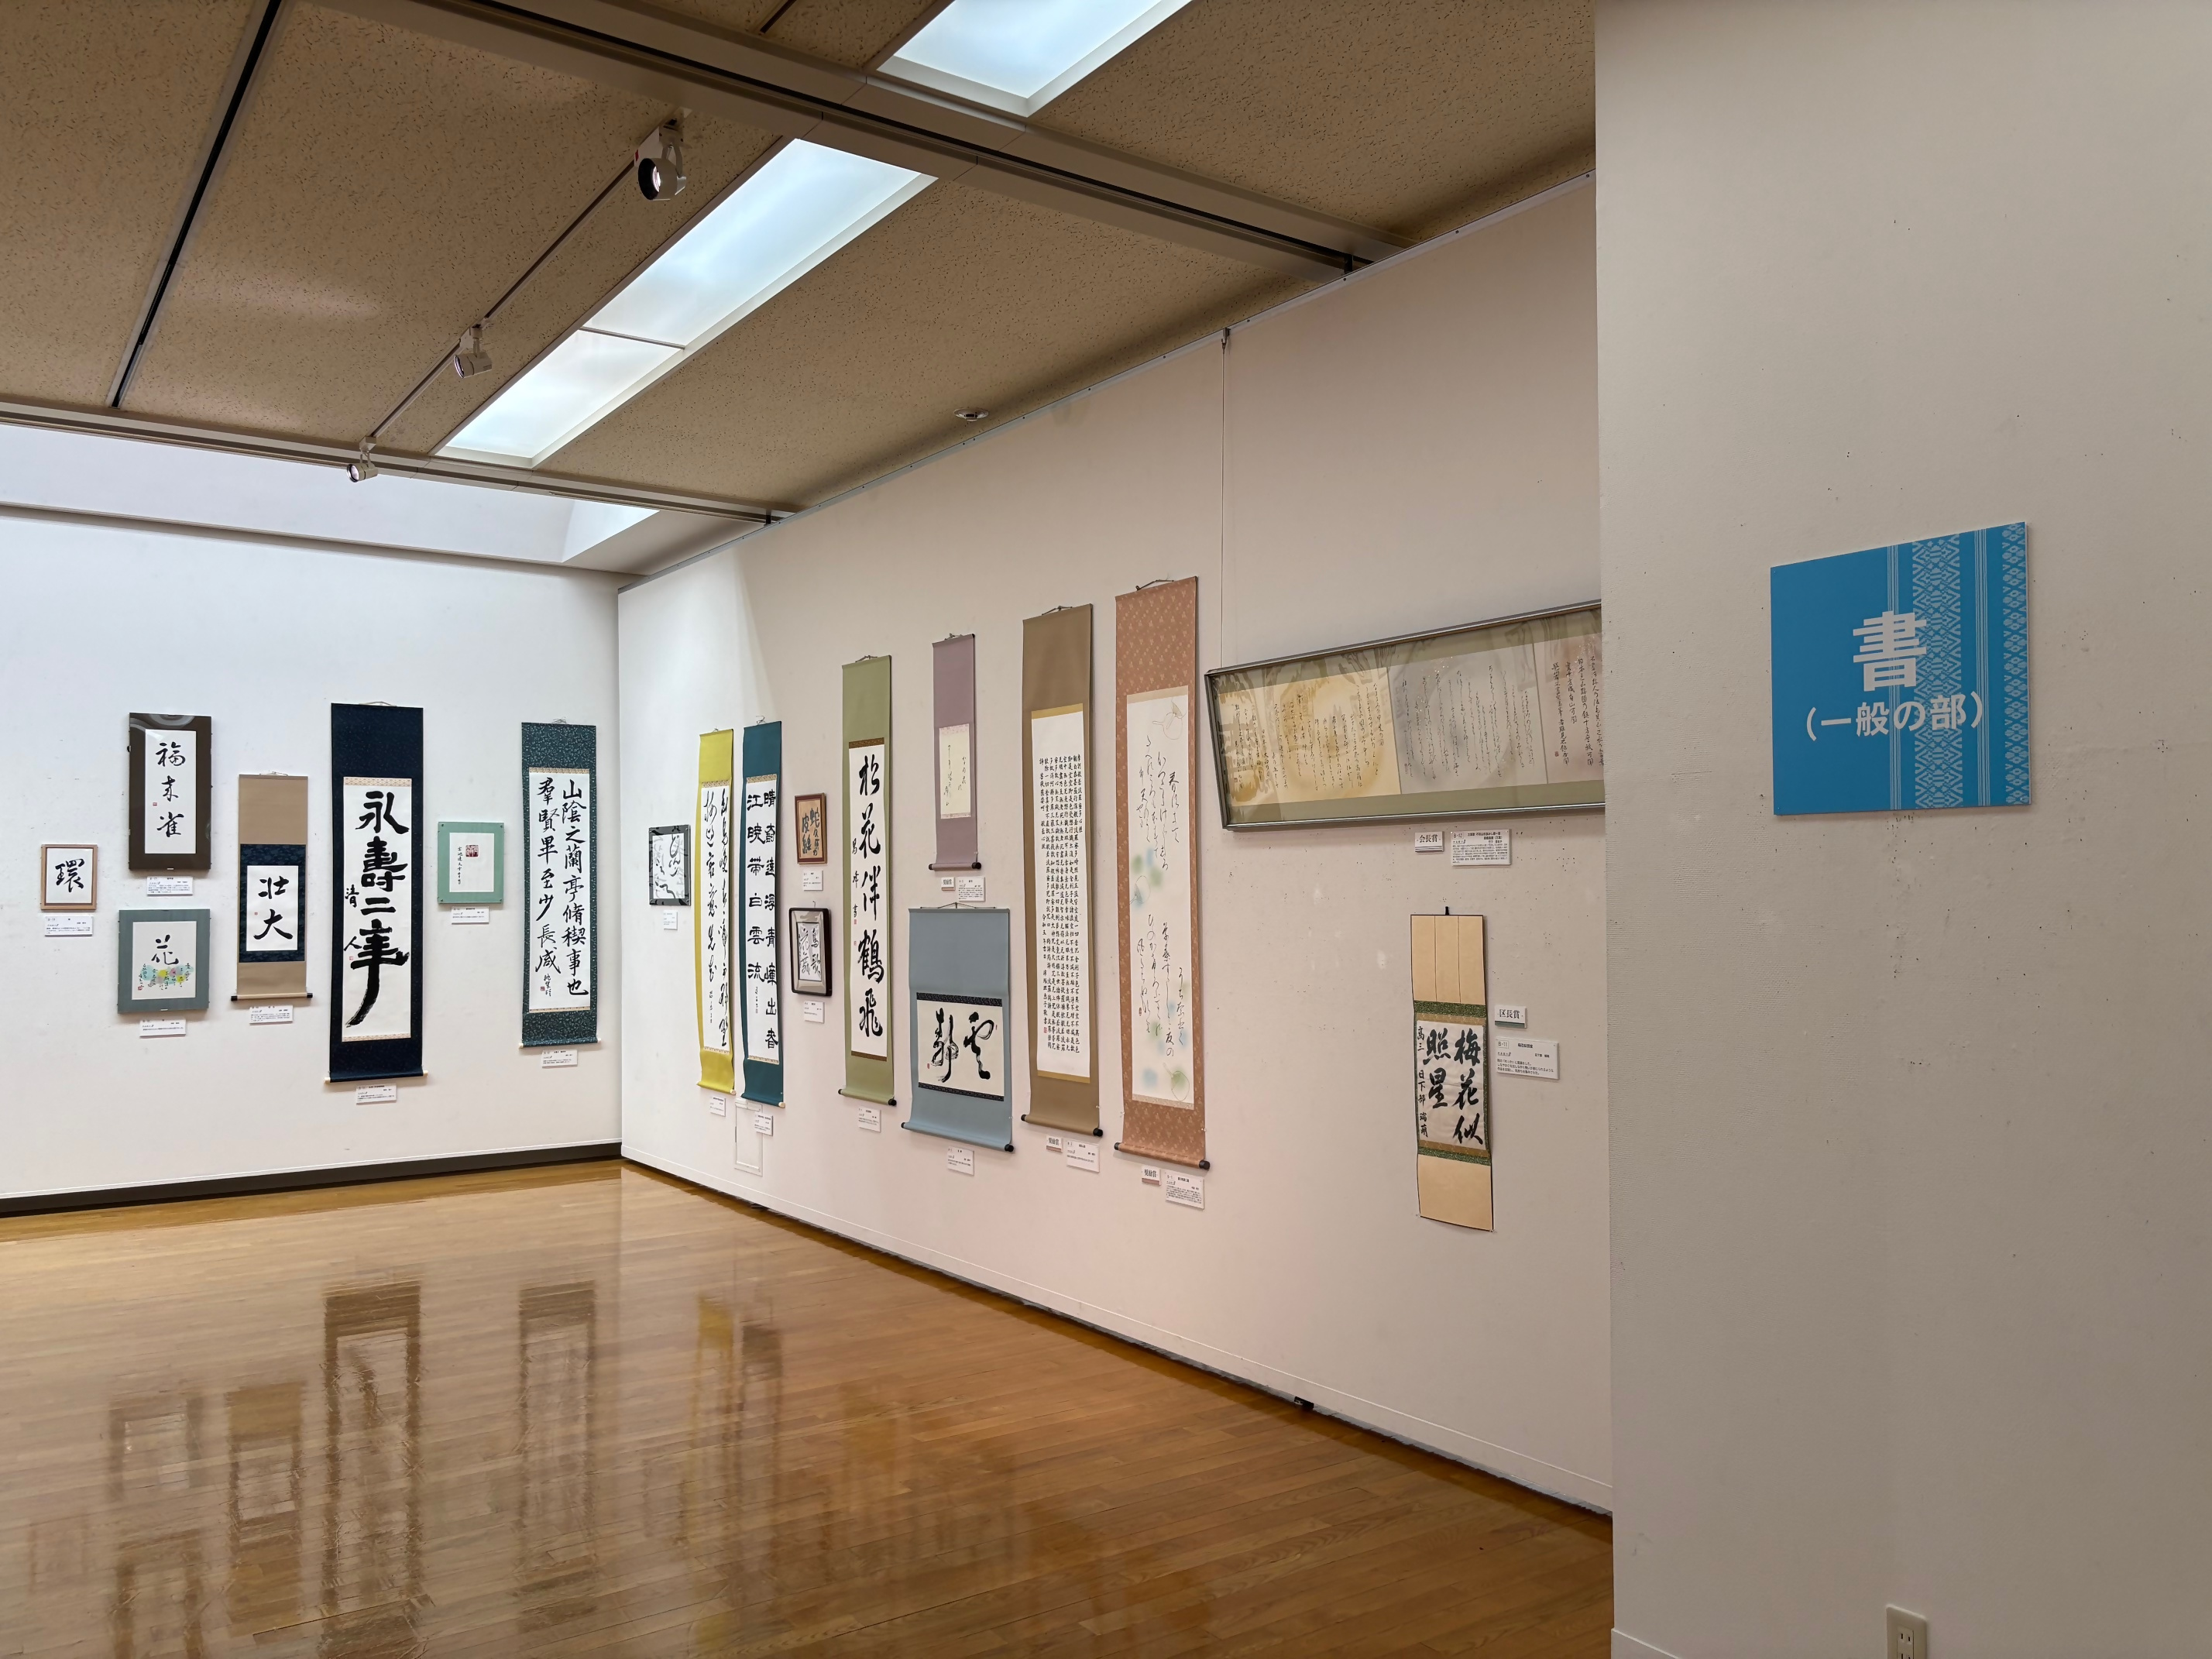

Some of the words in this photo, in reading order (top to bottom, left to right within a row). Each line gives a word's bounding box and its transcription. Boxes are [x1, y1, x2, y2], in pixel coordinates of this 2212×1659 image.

[1853, 611, 1927, 692] 書
[1806, 692, 1983, 740] （一般の部）
[1419, 834, 1438, 843] 会長賞
[54, 858, 84, 893] 環
[151, 934, 179, 966] 花
[1499, 1009, 1520, 1018] 区長賞
[1423, 1027, 1451, 1109] 照星
[1451, 1028, 1483, 1145] 梅花似
